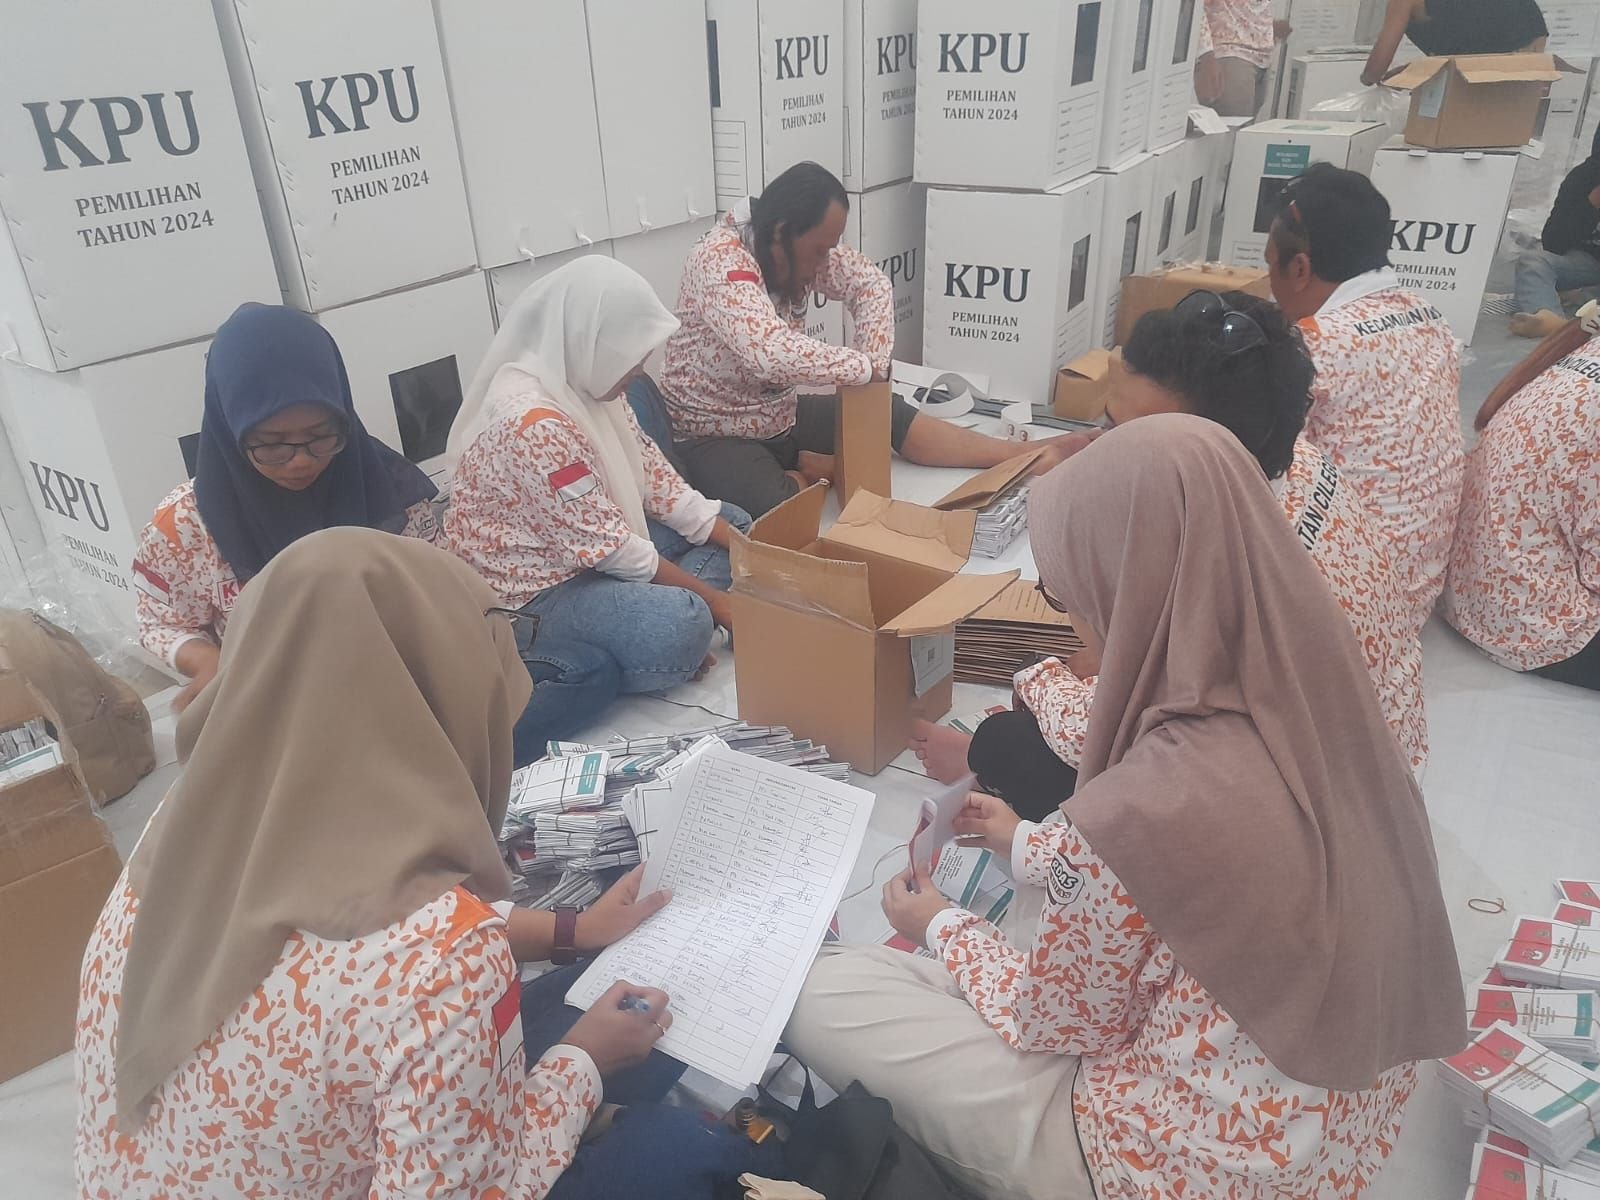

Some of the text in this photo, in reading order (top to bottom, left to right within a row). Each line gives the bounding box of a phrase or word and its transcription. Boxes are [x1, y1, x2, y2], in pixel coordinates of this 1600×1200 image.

[774, 34, 829, 80] KPU
[937, 32, 1030, 73] KPU
[294, 65, 420, 139] KPU
[783, 93, 824, 112] PEMILIHAN
[947, 89, 1017, 102] PEMILIHAN
[21, 90, 200, 171] KPU
[781, 111, 827, 130] TAHUN 2024
[943, 107, 1018, 121] TAHUN 2024
[331, 146, 421, 179] PEMILIHAN
[75, 182, 202, 218] PEMILIHAN
[331, 169, 430, 205] TAHUN 2024
[77, 209, 215, 248] TAHUN 2024
[1388, 220, 1477, 255] KPU
[943, 262, 1032, 303] KPU
[1394, 263, 1457, 277] EMILIHAN
[1425, 280, 1457, 291] 2024
[948, 326, 1020, 343] TAHUN 2024
[952, 311, 1019, 327] PEMILIHAN
[29, 460, 110, 533] KPU
[101, 568, 130, 592] 2024
